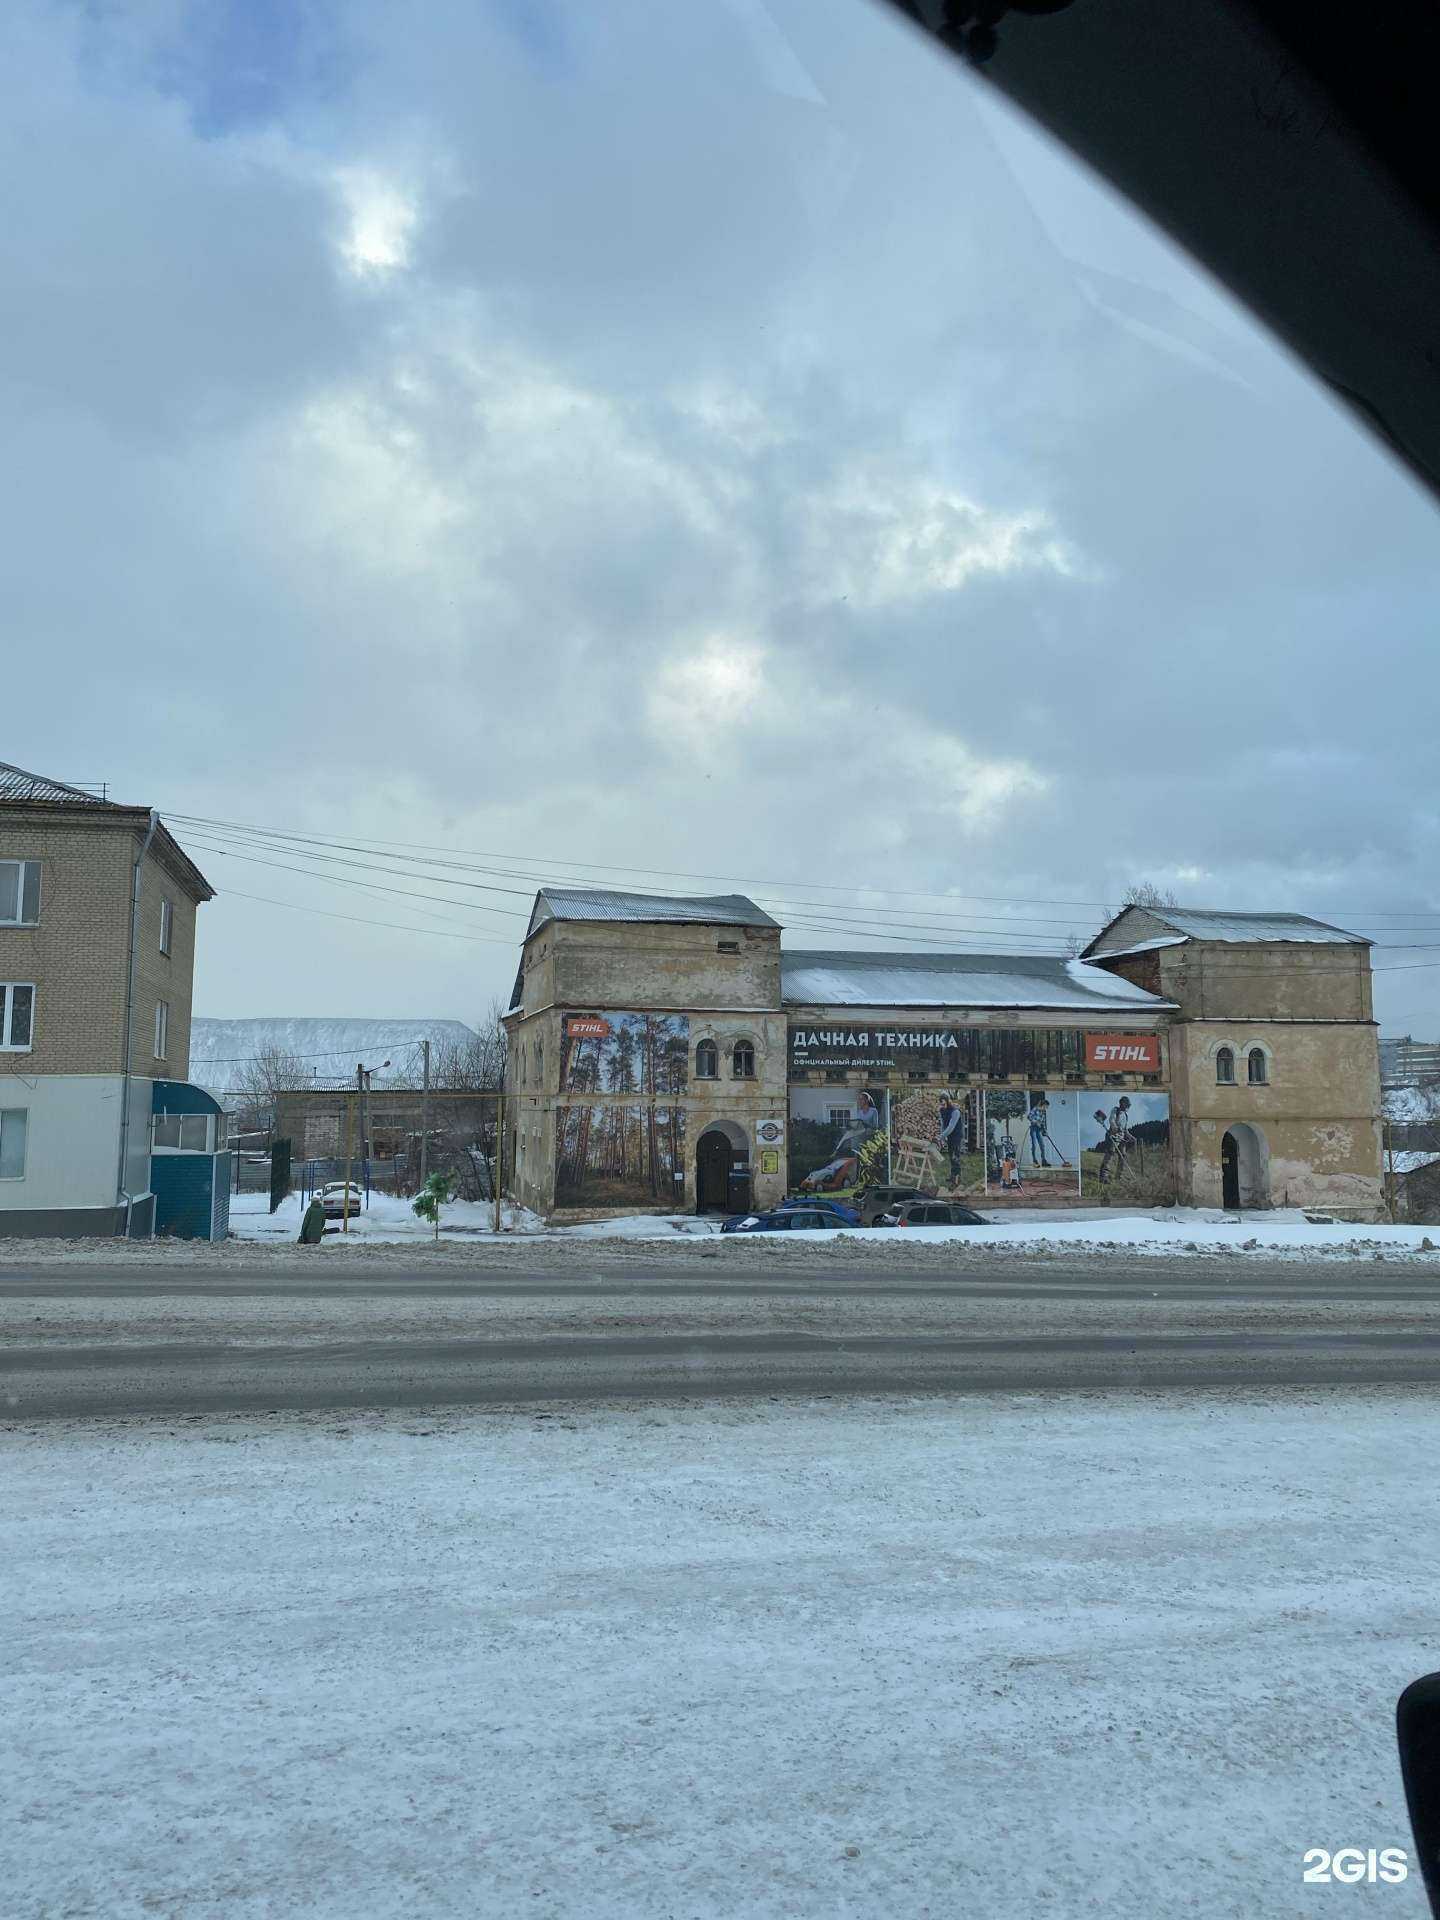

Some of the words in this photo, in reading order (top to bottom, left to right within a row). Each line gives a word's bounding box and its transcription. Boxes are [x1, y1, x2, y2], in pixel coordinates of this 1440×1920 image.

[571, 1024, 603, 1032] STIHL
[793, 1031, 869, 1047] ДАЧНАЯ
[875, 1033, 958, 1048] ТЕХНИКА
[1094, 1045, 1151, 1060] STIHL
